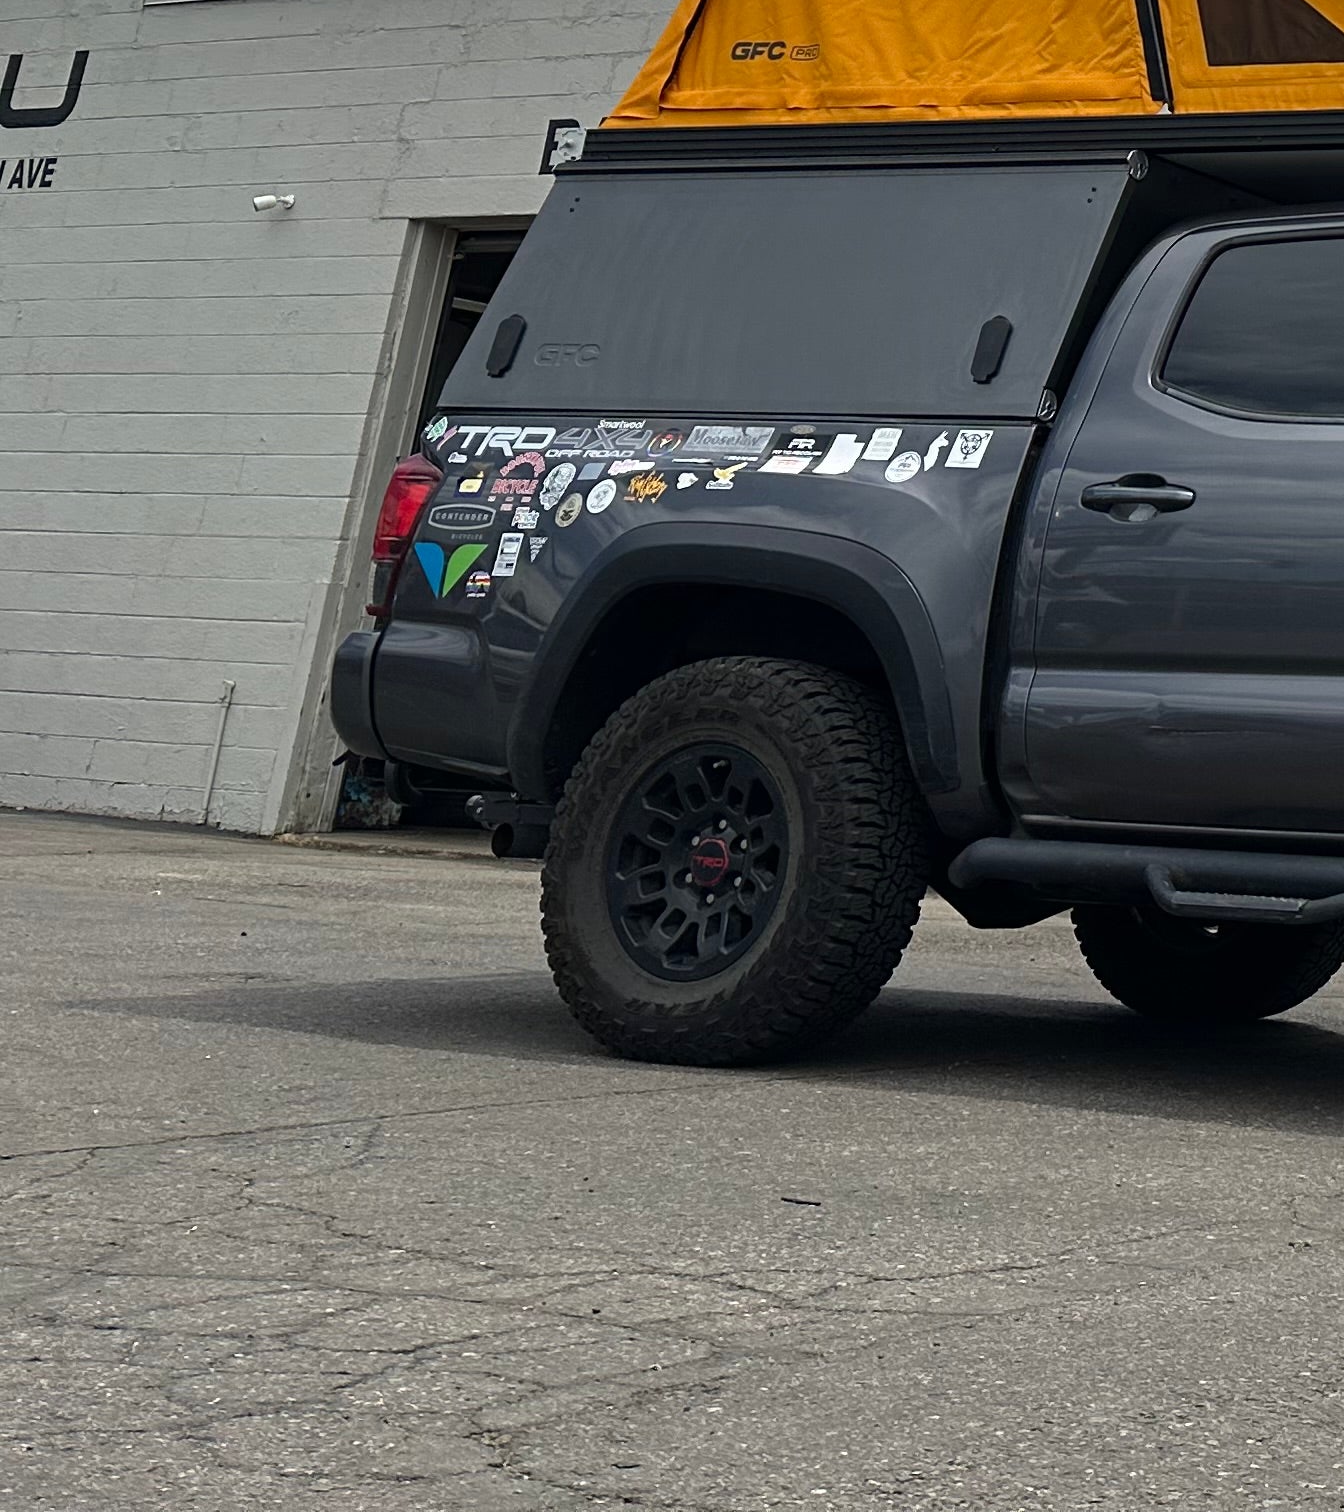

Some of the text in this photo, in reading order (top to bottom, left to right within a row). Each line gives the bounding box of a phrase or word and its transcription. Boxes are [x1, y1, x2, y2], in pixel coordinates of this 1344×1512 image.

[731, 40, 818, 61] GFC PRO
[7, 157, 58, 189] AVE
[534, 343, 601, 367] GFC
[597, 419, 646, 429] Smartwool
[457, 425, 556, 457] TRD
[544, 449, 636, 458] OFF ROAD
[435, 511, 489, 522] CONTENDER
